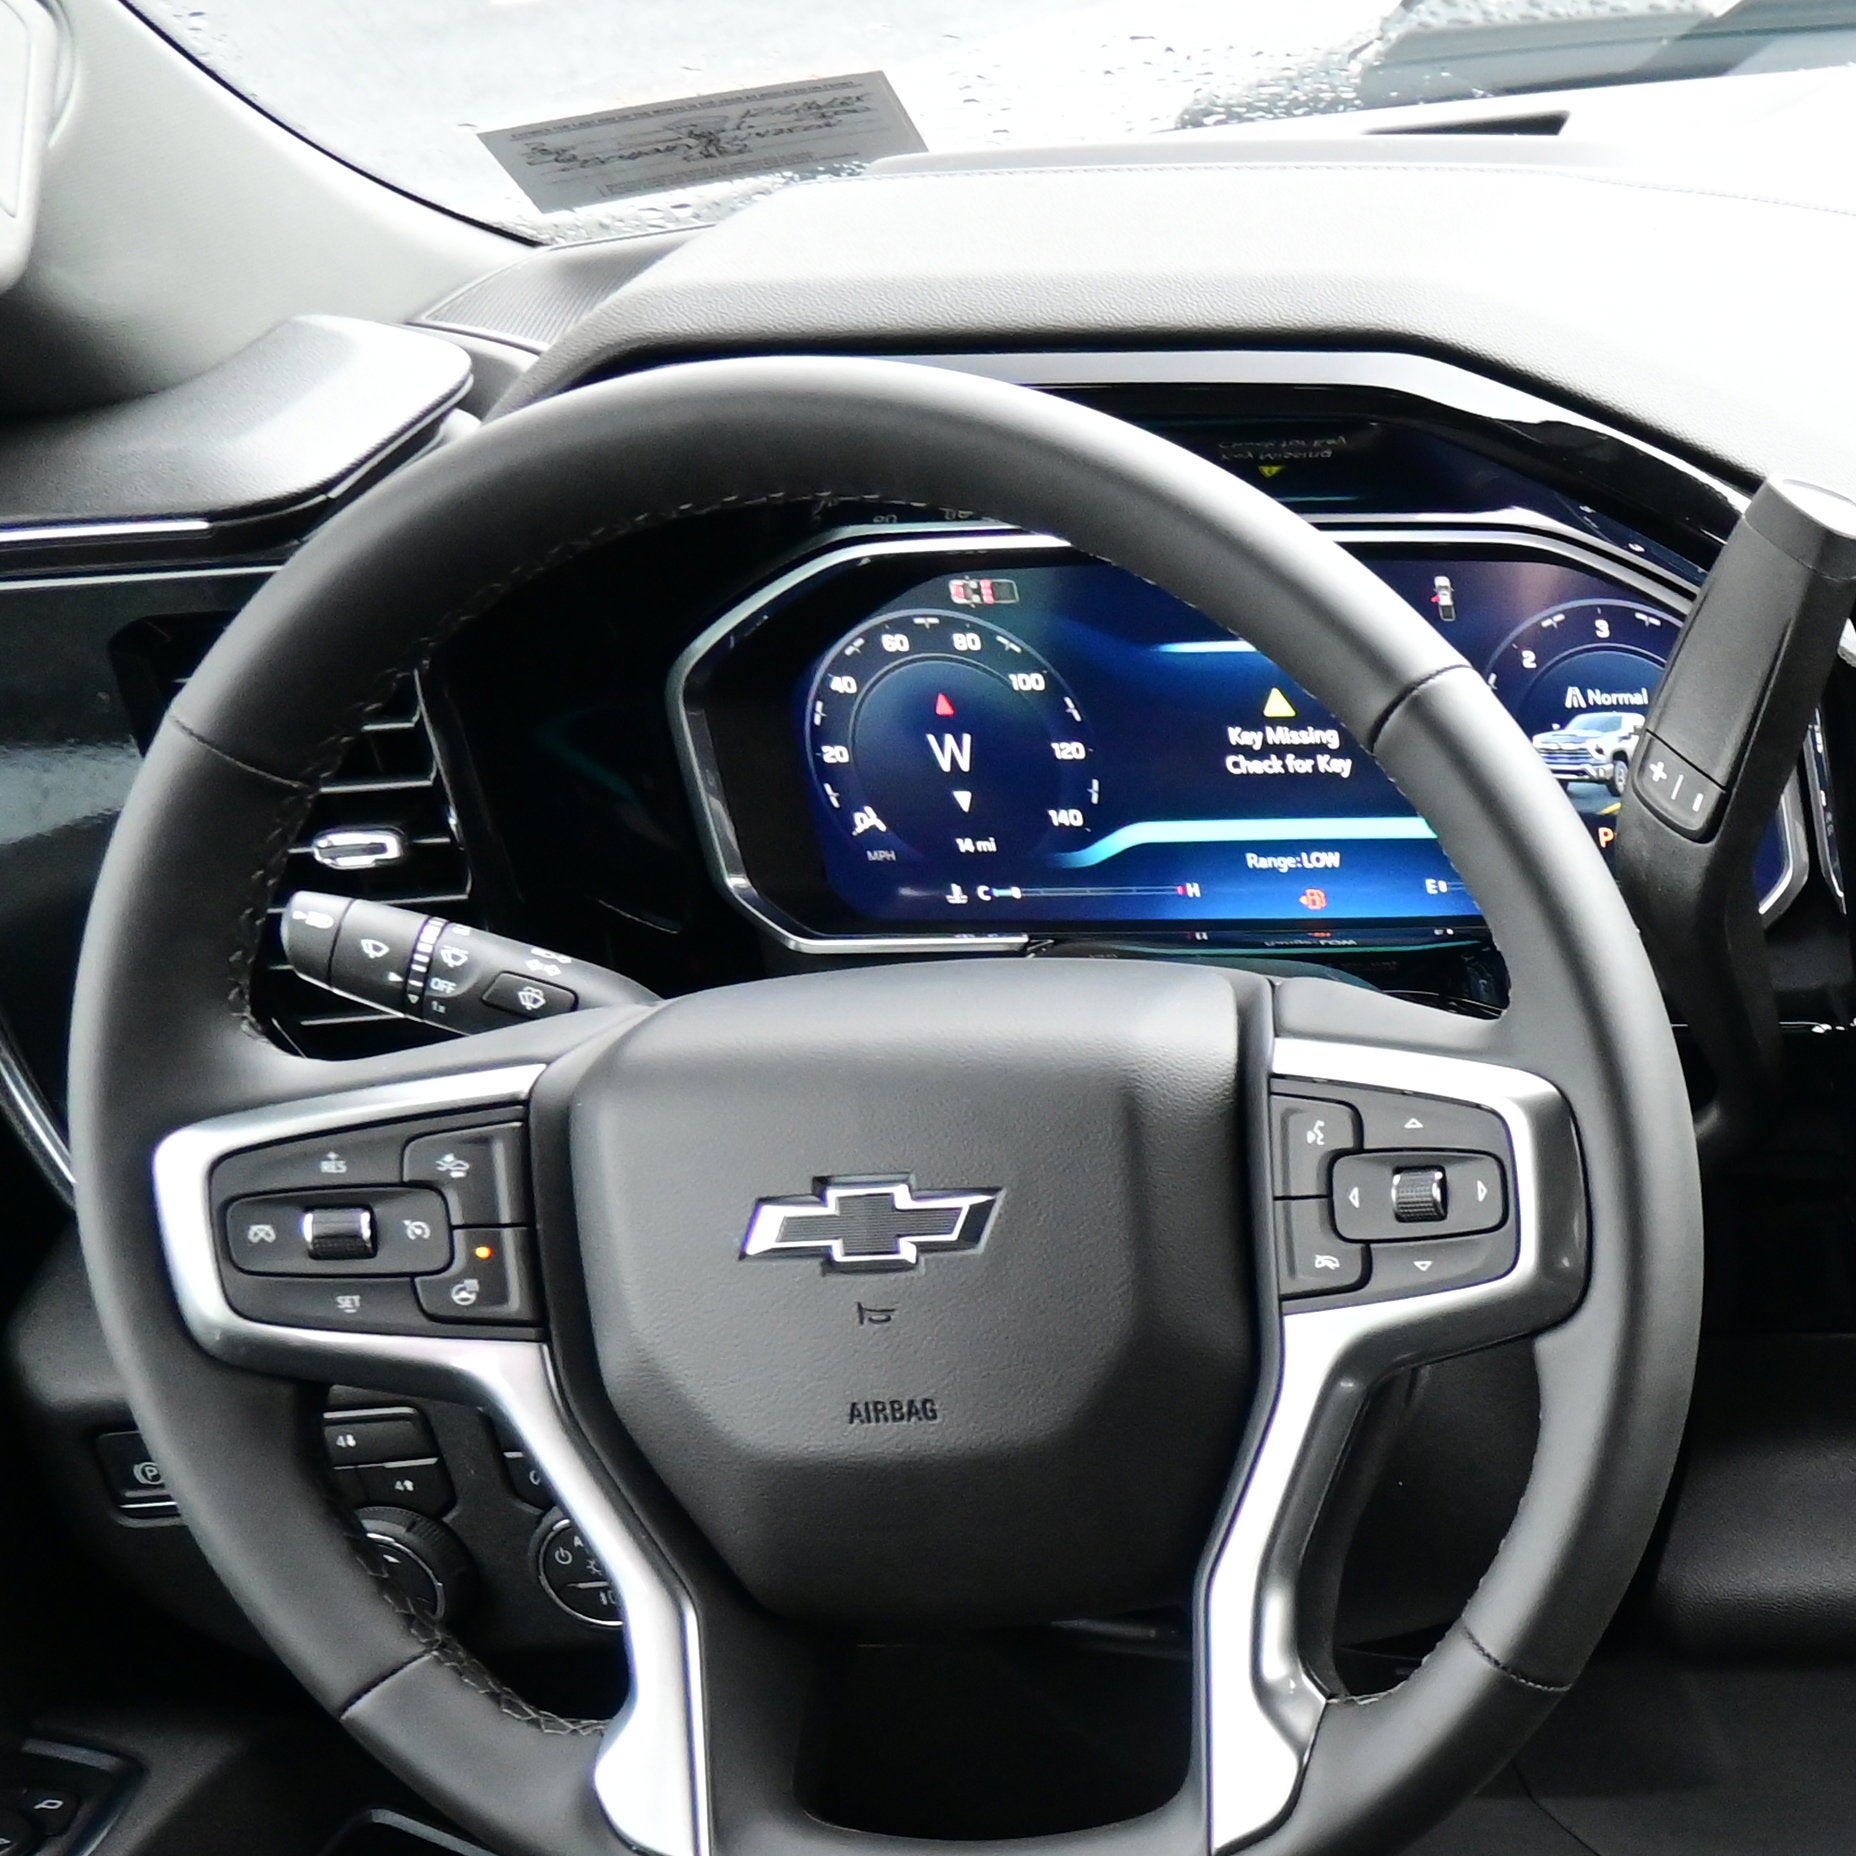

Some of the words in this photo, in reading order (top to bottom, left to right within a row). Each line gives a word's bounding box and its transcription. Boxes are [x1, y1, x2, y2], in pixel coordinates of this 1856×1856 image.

[1595, 619, 1610, 638] 3
[881, 633, 910, 652] 60
[952, 633, 981, 652] 80
[1521, 650, 1537, 669] 2
[830, 675, 858, 694] 40
[1008, 673, 1045, 691] 100
[1587, 688, 1648, 706] Normal
[1227, 726, 1263, 751] Key
[1265, 725, 1340, 748] Missing
[821, 745, 850, 764] 20
[926, 733, 971, 773] W
[1050, 741, 1086, 760] 120
[1225, 755, 1285, 775] Check
[1286, 754, 1314, 773] for
[1317, 755, 1352, 778] Key
[1048, 809, 1084, 827] 140
[976, 837, 997, 853] mi
[1598, 827, 1614, 848] P
[867, 850, 896, 862] MPH
[1245, 852, 1300, 872] Range:
[1302, 851, 1340, 868] LOW
[1186, 882, 1201, 898] H
[1425, 879, 1438, 894] E
[429, 977, 457, 994] OFF
[321, 1158, 347, 1174] RES
[337, 1295, 360, 1309] SET
[849, 1398, 938, 1425] AIRBAG
